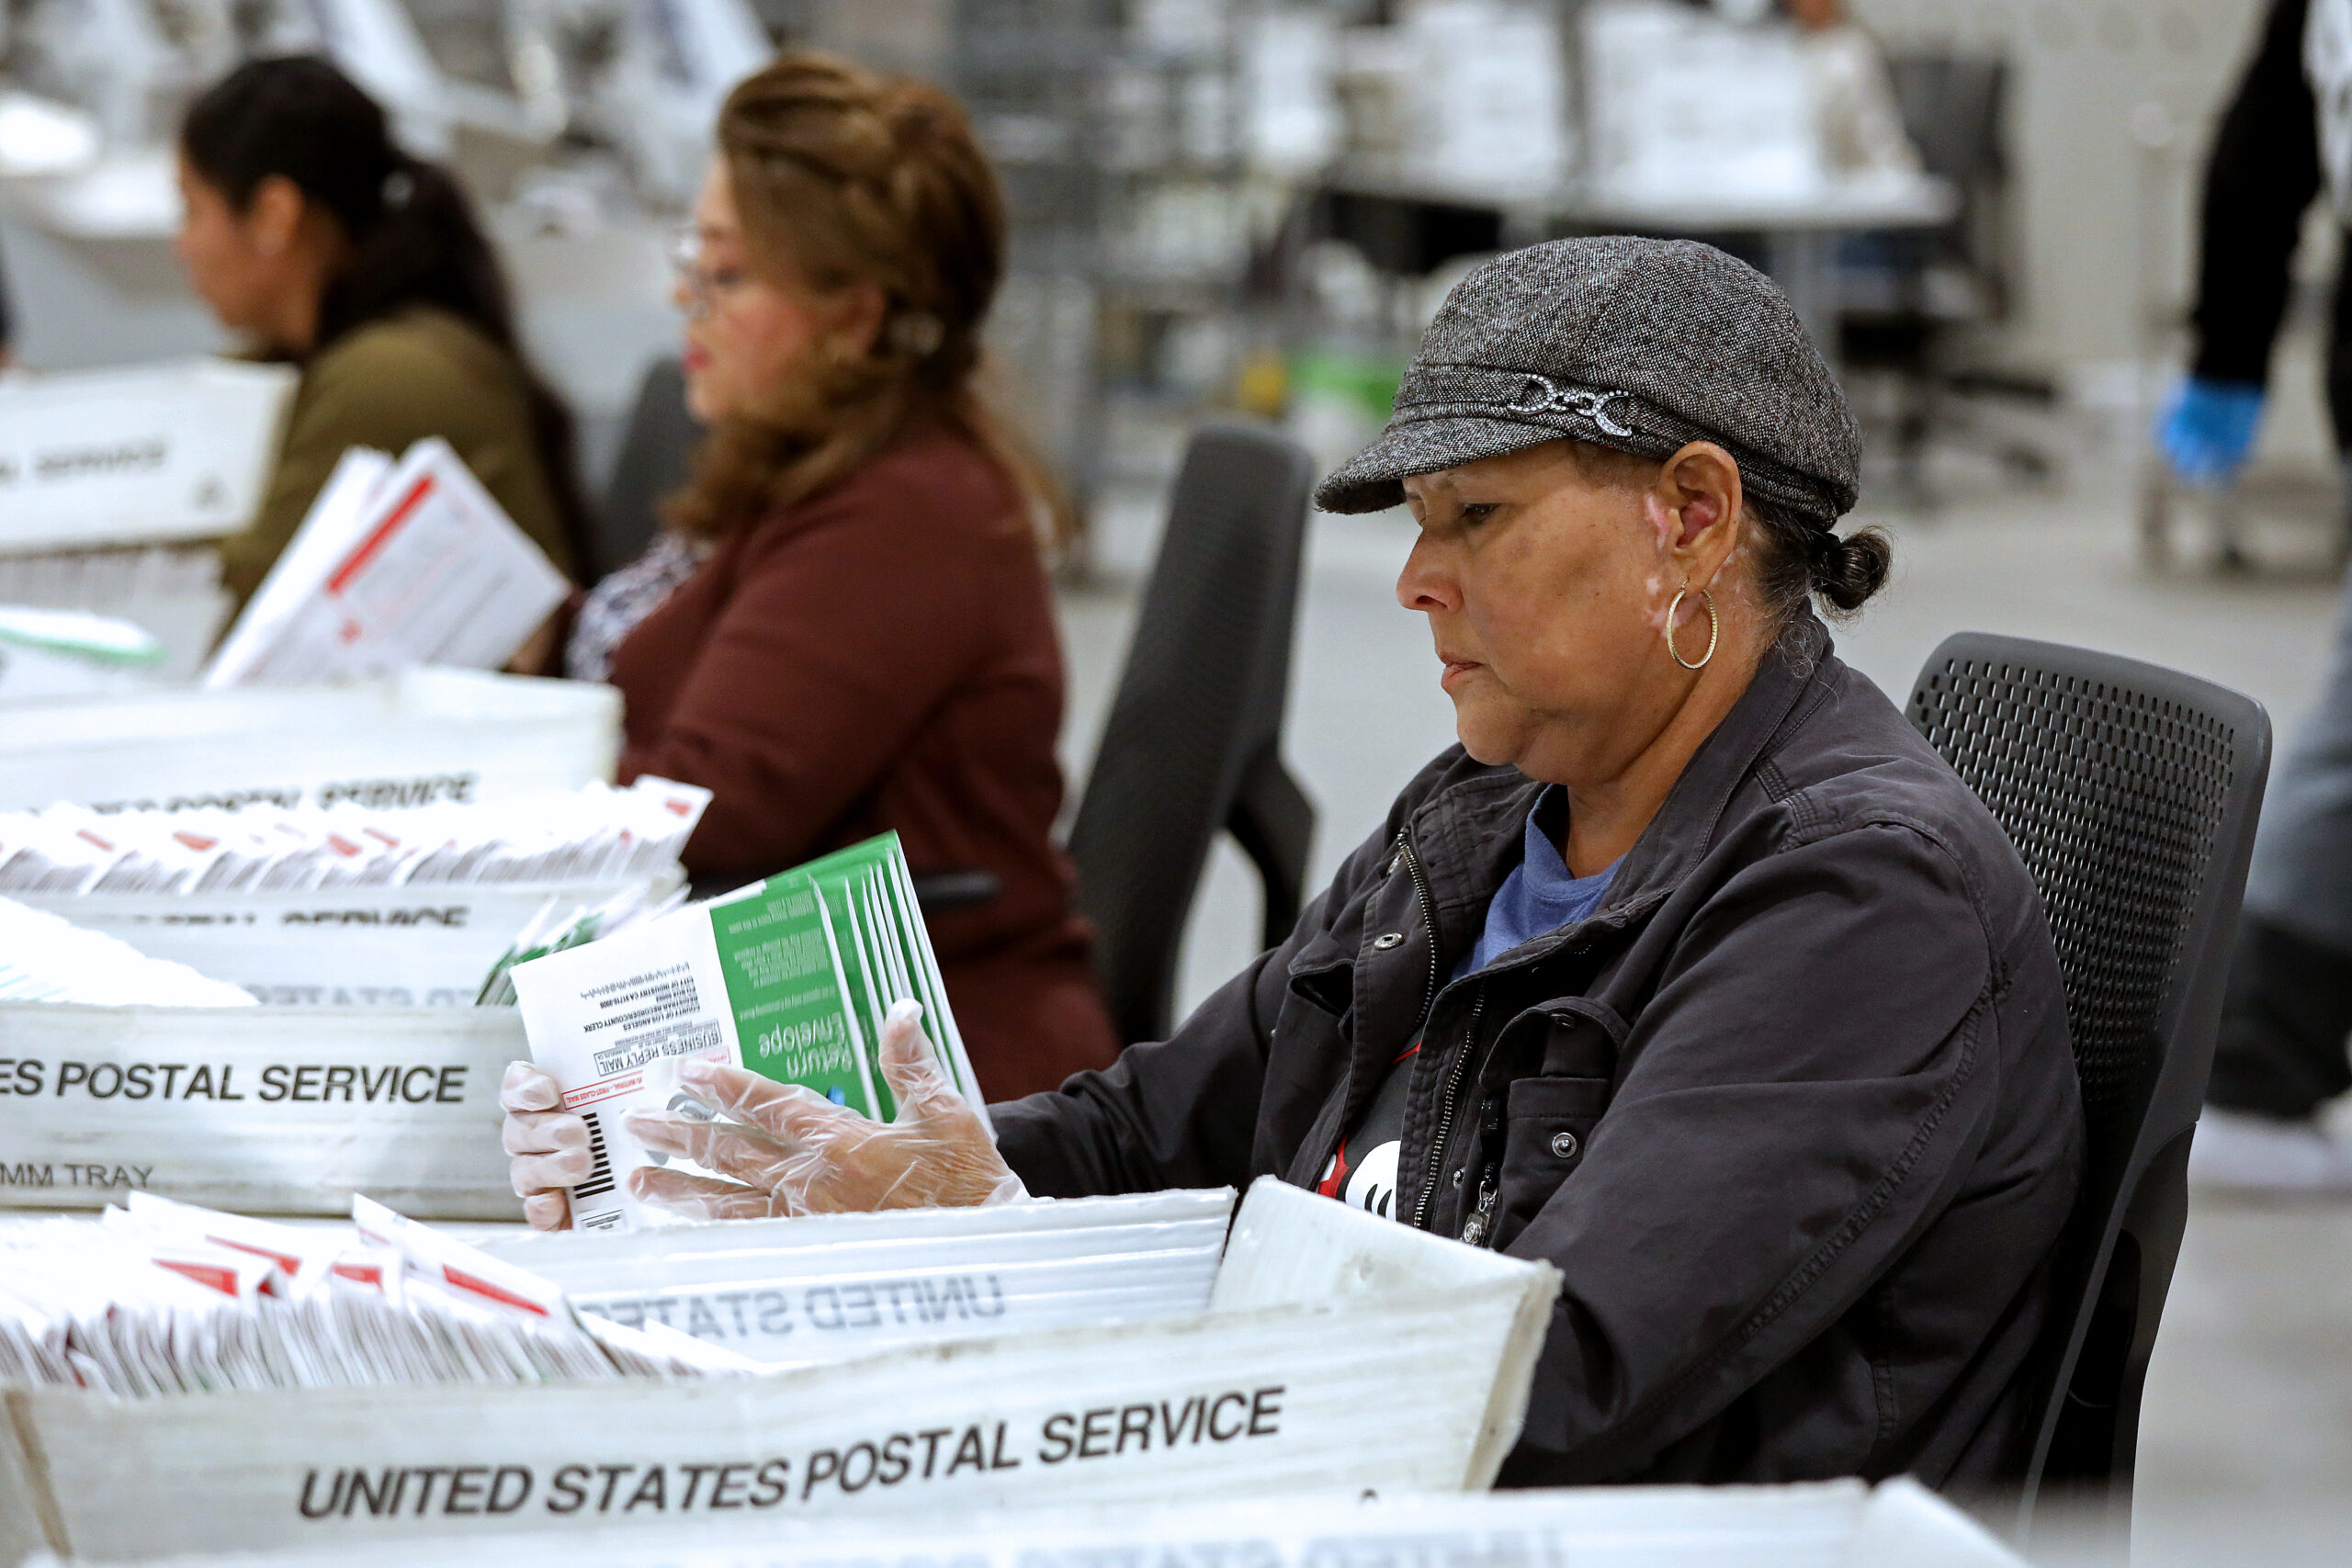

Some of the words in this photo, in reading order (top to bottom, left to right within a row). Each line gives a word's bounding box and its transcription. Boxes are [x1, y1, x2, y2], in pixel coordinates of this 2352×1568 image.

[583, 1021, 603, 1032] CLERK
[622, 1017, 651, 1032] ANGELES
[757, 1011, 845, 1057] Envelope
[626, 1045, 659, 1066] REPLY
[662, 1030, 722, 1056] BUSINESS
[599, 1056, 623, 1073] MAIL
[785, 1040, 854, 1080] Return
[56, 1060, 245, 1100] POSTAL
[258, 1064, 469, 1103] SERVICE
[64, 1163, 154, 1189] TRAY
[299, 1464, 534, 1519] UNITED
[547, 1459, 790, 1515] STATES
[801, 1420, 1021, 1501] POSTAL
[1037, 1385, 1286, 1464] SERVICE
